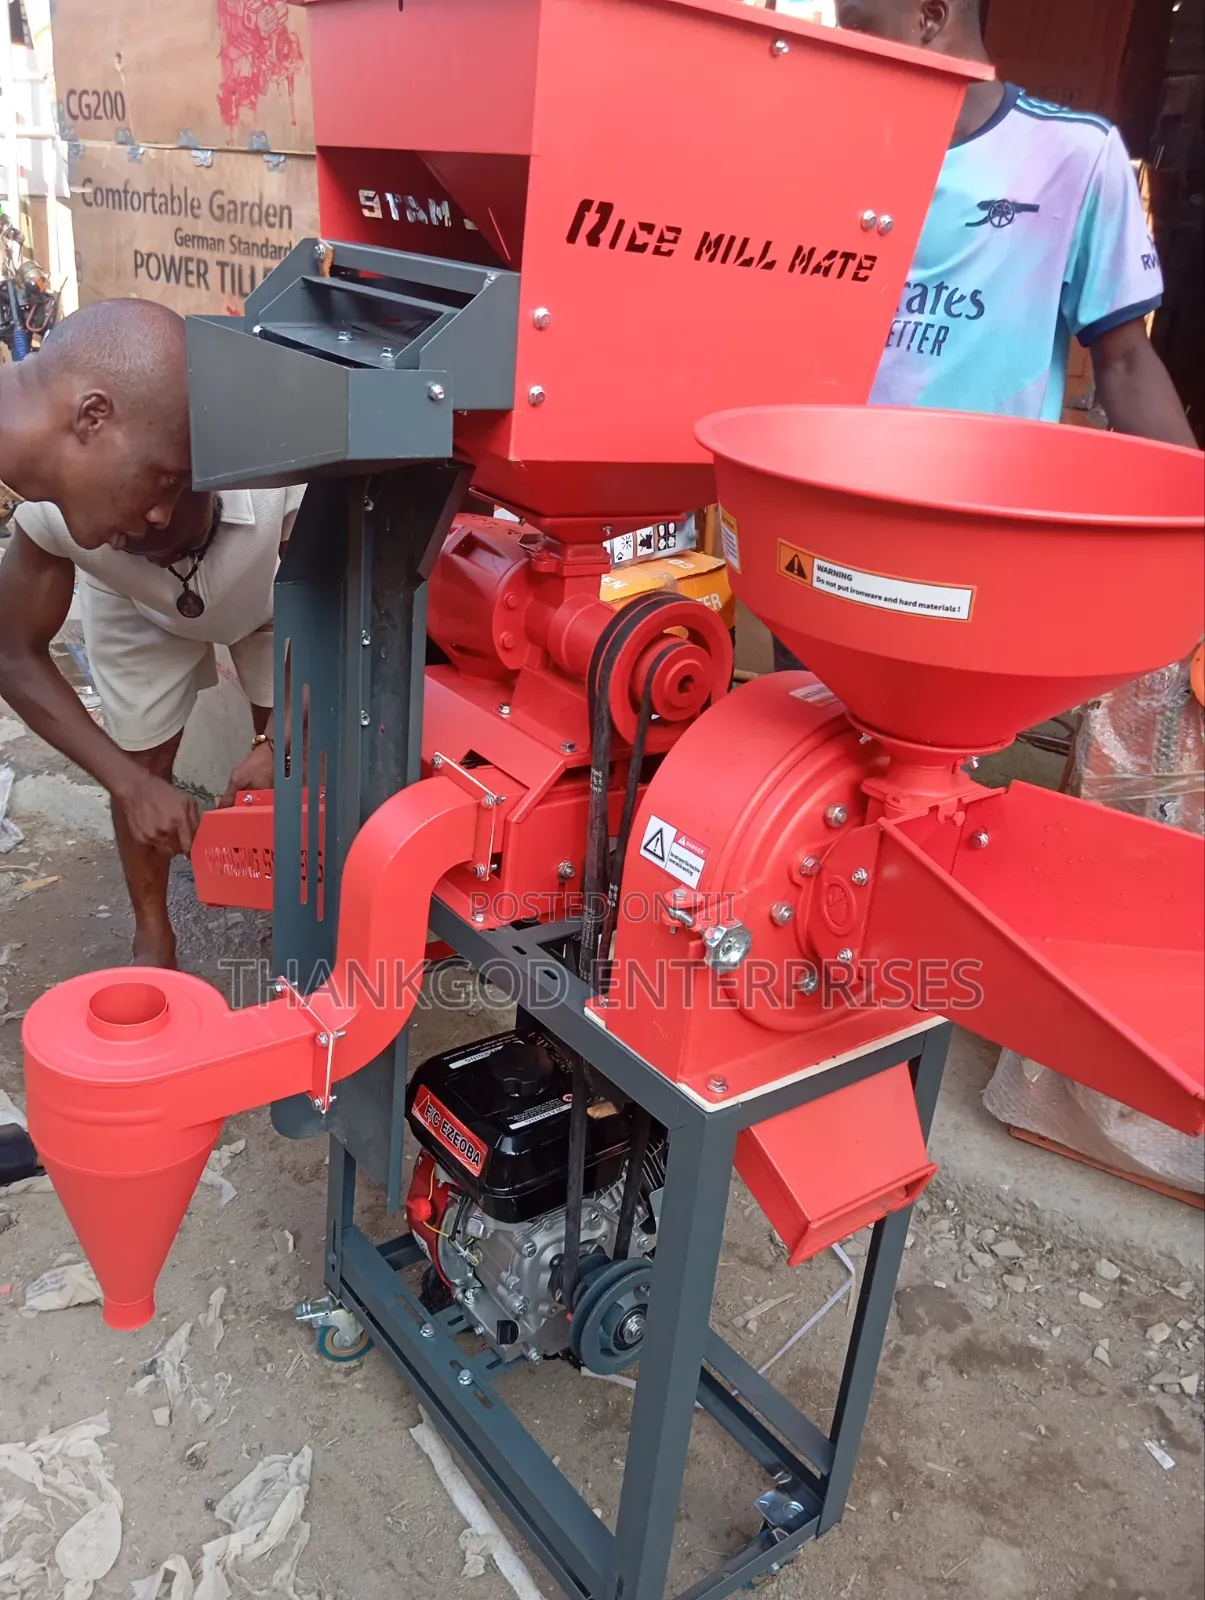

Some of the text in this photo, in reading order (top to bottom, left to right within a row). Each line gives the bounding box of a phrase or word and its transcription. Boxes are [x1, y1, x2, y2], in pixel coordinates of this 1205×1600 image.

[66, 89, 126, 122] CG200
[81, 177, 293, 230] Comfortable Garden
[174, 228, 226, 253] German
[566, 198, 877, 282] RICE MILL MATE
[134, 250, 210, 290] POWER
[816, 563, 853, 582] WARNING
[816, 576, 825, 585] Do
[825, 580, 837, 589] not
[837, 584, 850, 593] put
[849, 586, 883, 601] ironware
[883, 595, 898, 605] and
[898, 597, 918, 608] hard
[918, 602, 957, 613] materials
[685, 841, 704, 855] DANGER
[441, 1119, 481, 1167] EZEOBA
